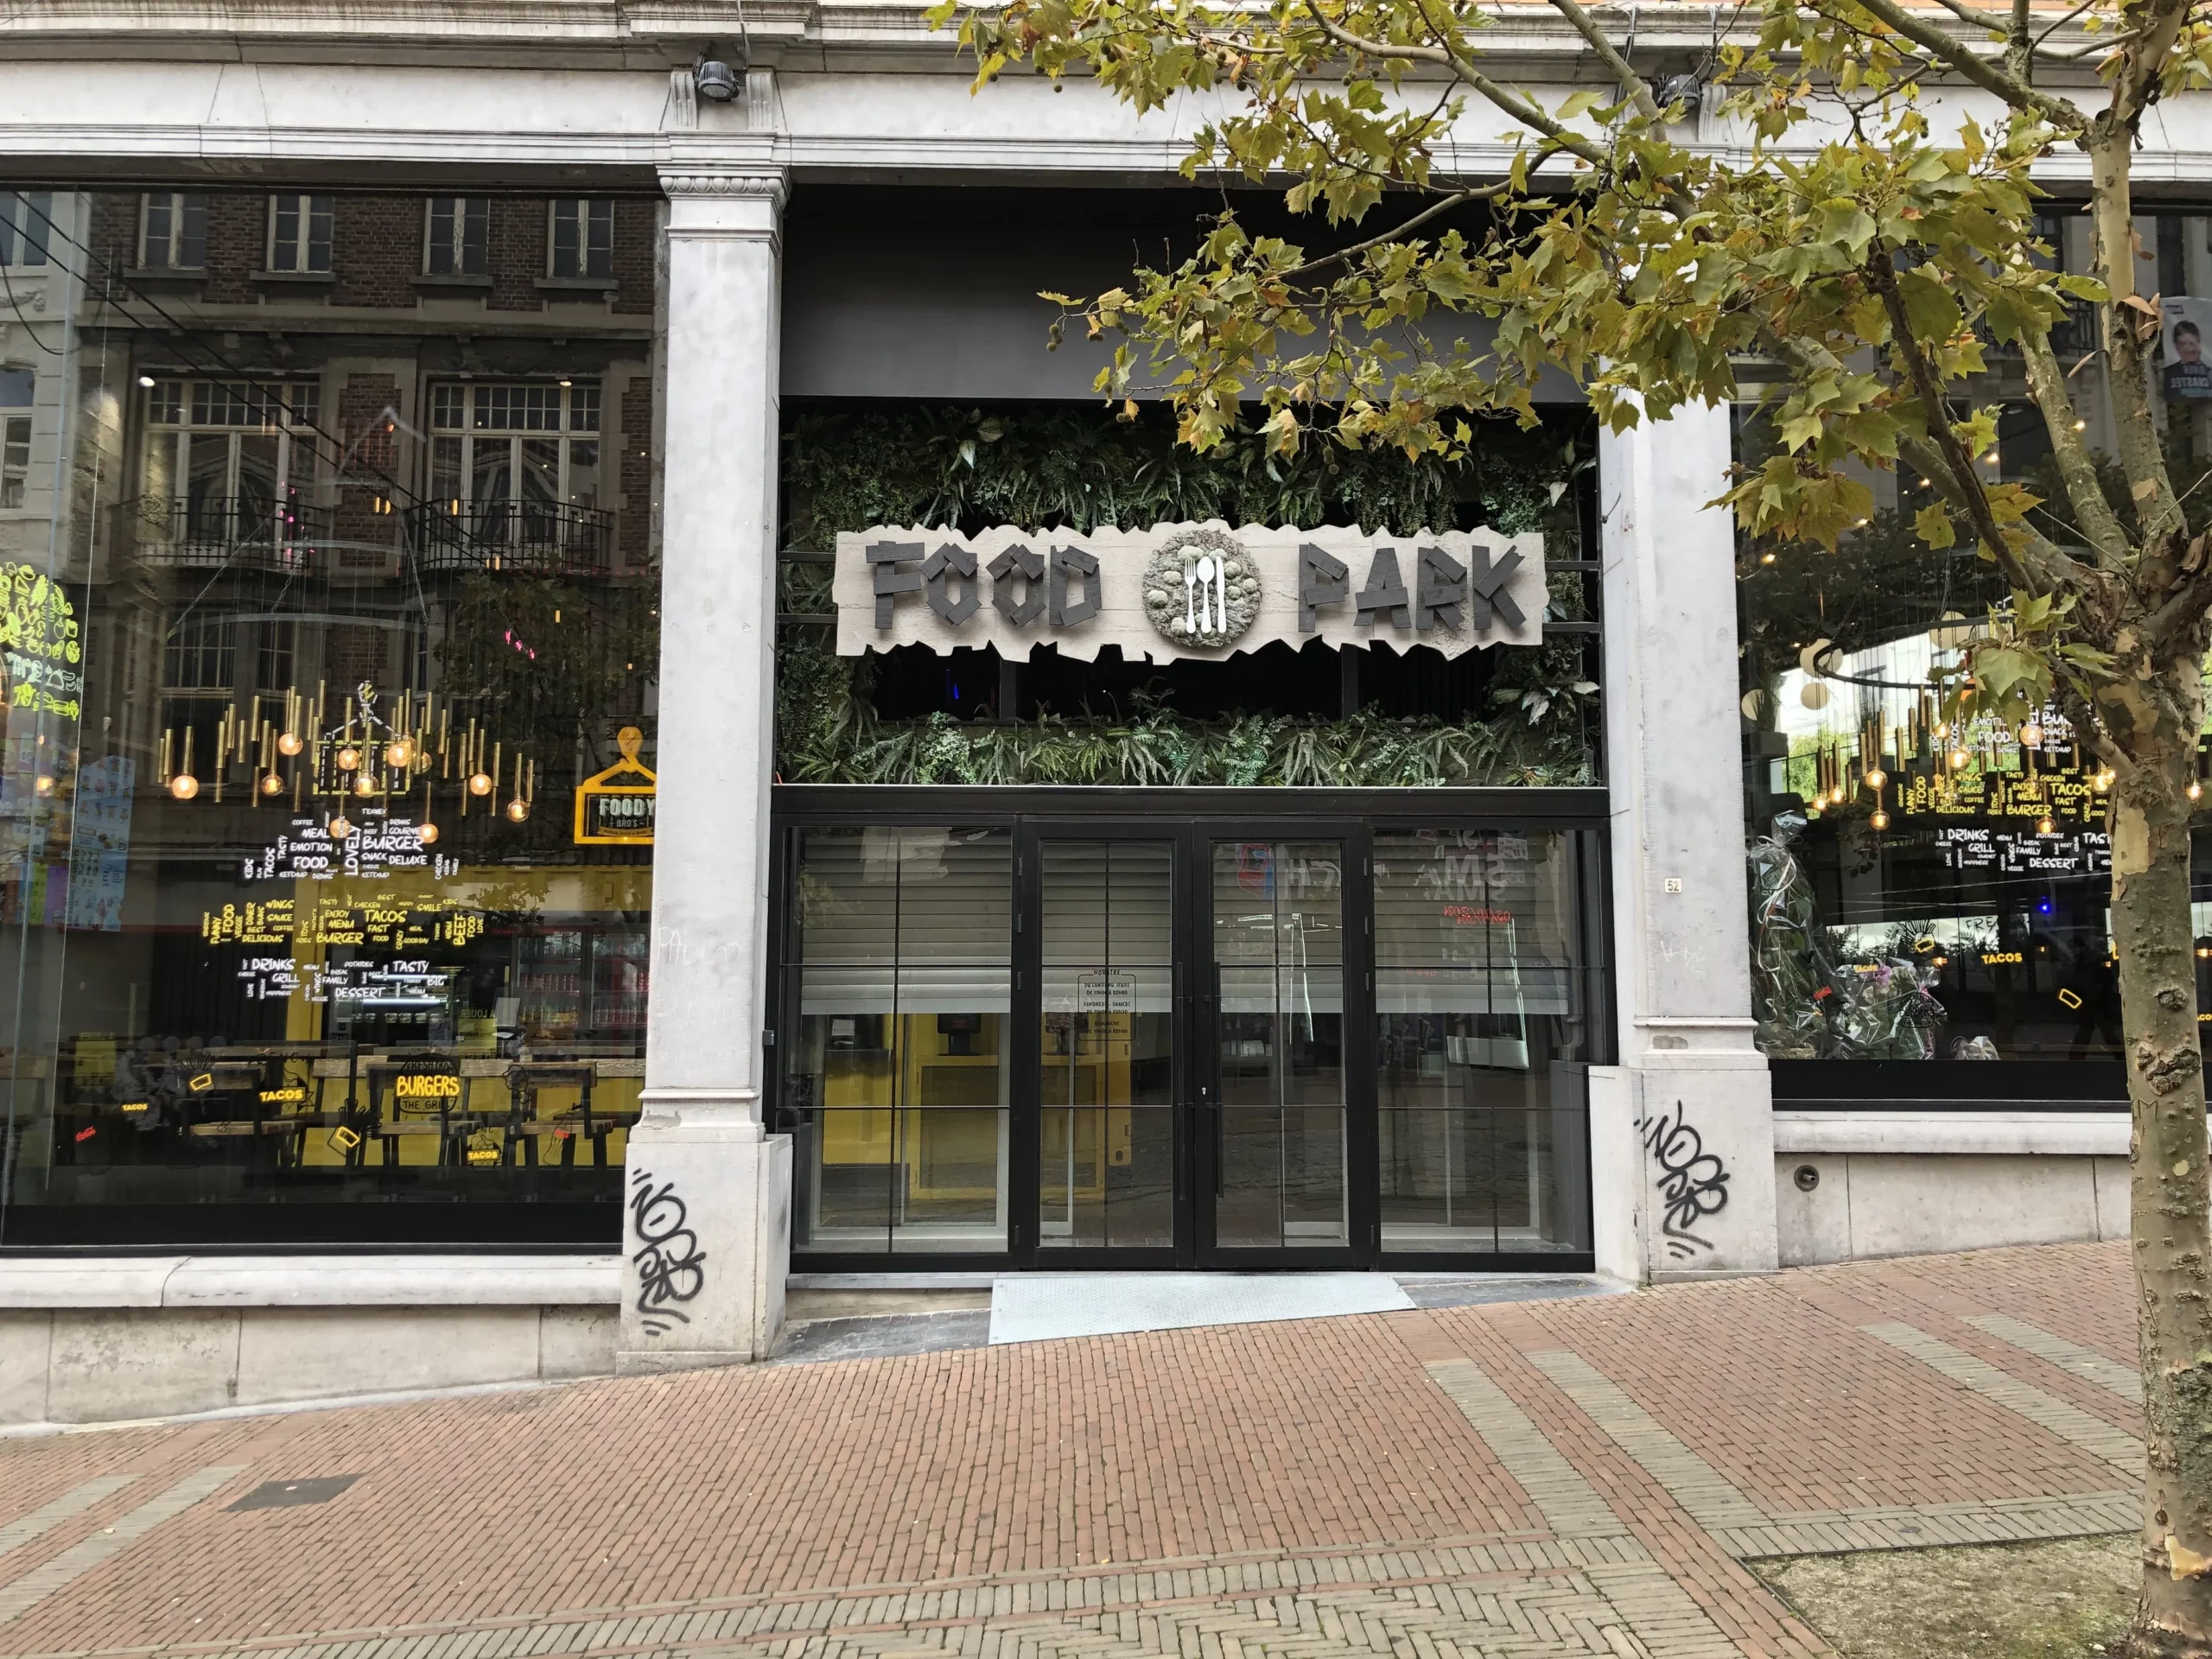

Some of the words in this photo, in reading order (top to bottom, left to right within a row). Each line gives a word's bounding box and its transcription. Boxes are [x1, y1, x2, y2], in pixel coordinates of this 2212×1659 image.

[866, 541, 1103, 630] FOOD
[1298, 541, 1526, 632] PARK
[1978, 731, 2011, 743] FOOD
[1955, 772, 1982, 781] WINGS
[1916, 776, 1926, 804] FOOD
[1957, 785, 1982, 794] SAUCE
[2050, 783, 2091, 796] TACOS
[1906, 788, 1915, 815] FUNNY
[2017, 792, 2042, 801] MENU
[2006, 804, 2052, 817] BURGER
[302, 828, 330, 839] MEAL
[1948, 829, 1989, 842] DRINKS
[277, 835, 288, 860] TASTY
[289, 842, 334, 852] EMOTION
[363, 835, 424, 852] BURGER
[1968, 843, 1995, 853] GRILL
[344, 824, 361, 876] LOVELY
[2016, 847, 2041, 855] FAMILY
[294, 856, 328, 869] FOOD
[361, 852, 388, 861] SNACK
[389, 855, 428, 865] DELUXE
[245, 858, 254, 879] KIDS
[264, 847, 276, 879] TACOS
[435, 854, 443, 880] CHICKEN
[2030, 857, 2080, 870] DESSERT
[1668, 880, 1679, 891] 52
[265, 899, 295, 909] WINGS
[416, 903, 442, 912] SMILE
[222, 904, 235, 933] FOOD
[245, 902, 256, 925] DINER
[266, 913, 294, 922] SAUCE
[325, 909, 350, 918] ENJOY
[364, 909, 408, 923] TACOS
[301, 920, 309, 937] TOYS
[328, 919, 354, 929] MENU
[367, 924, 391, 933] FAST
[453, 912, 467, 945] BEEF
[467, 915, 476, 938] FOOD
[210, 917, 222, 944] FUNNY
[242, 934, 284, 943] DELICIOUS
[316, 932, 364, 944] BURGER
[251, 958, 296, 971] DRINKS
[1982, 952, 2023, 965] TACOS
[392, 960, 429, 974] TASTY
[272, 973, 301, 983] GRILL
[322, 976, 348, 985] FAMILY
[427, 976, 445, 987] BIG
[334, 987, 386, 999] DESSERT
[396, 1075, 461, 1096] BURGERS
[259, 1089, 303, 1103] TACOS
[122, 1103, 149, 1111] TACOS
[403, 1100, 420, 1109] THE
[467, 1150, 498, 1160] TACOS
